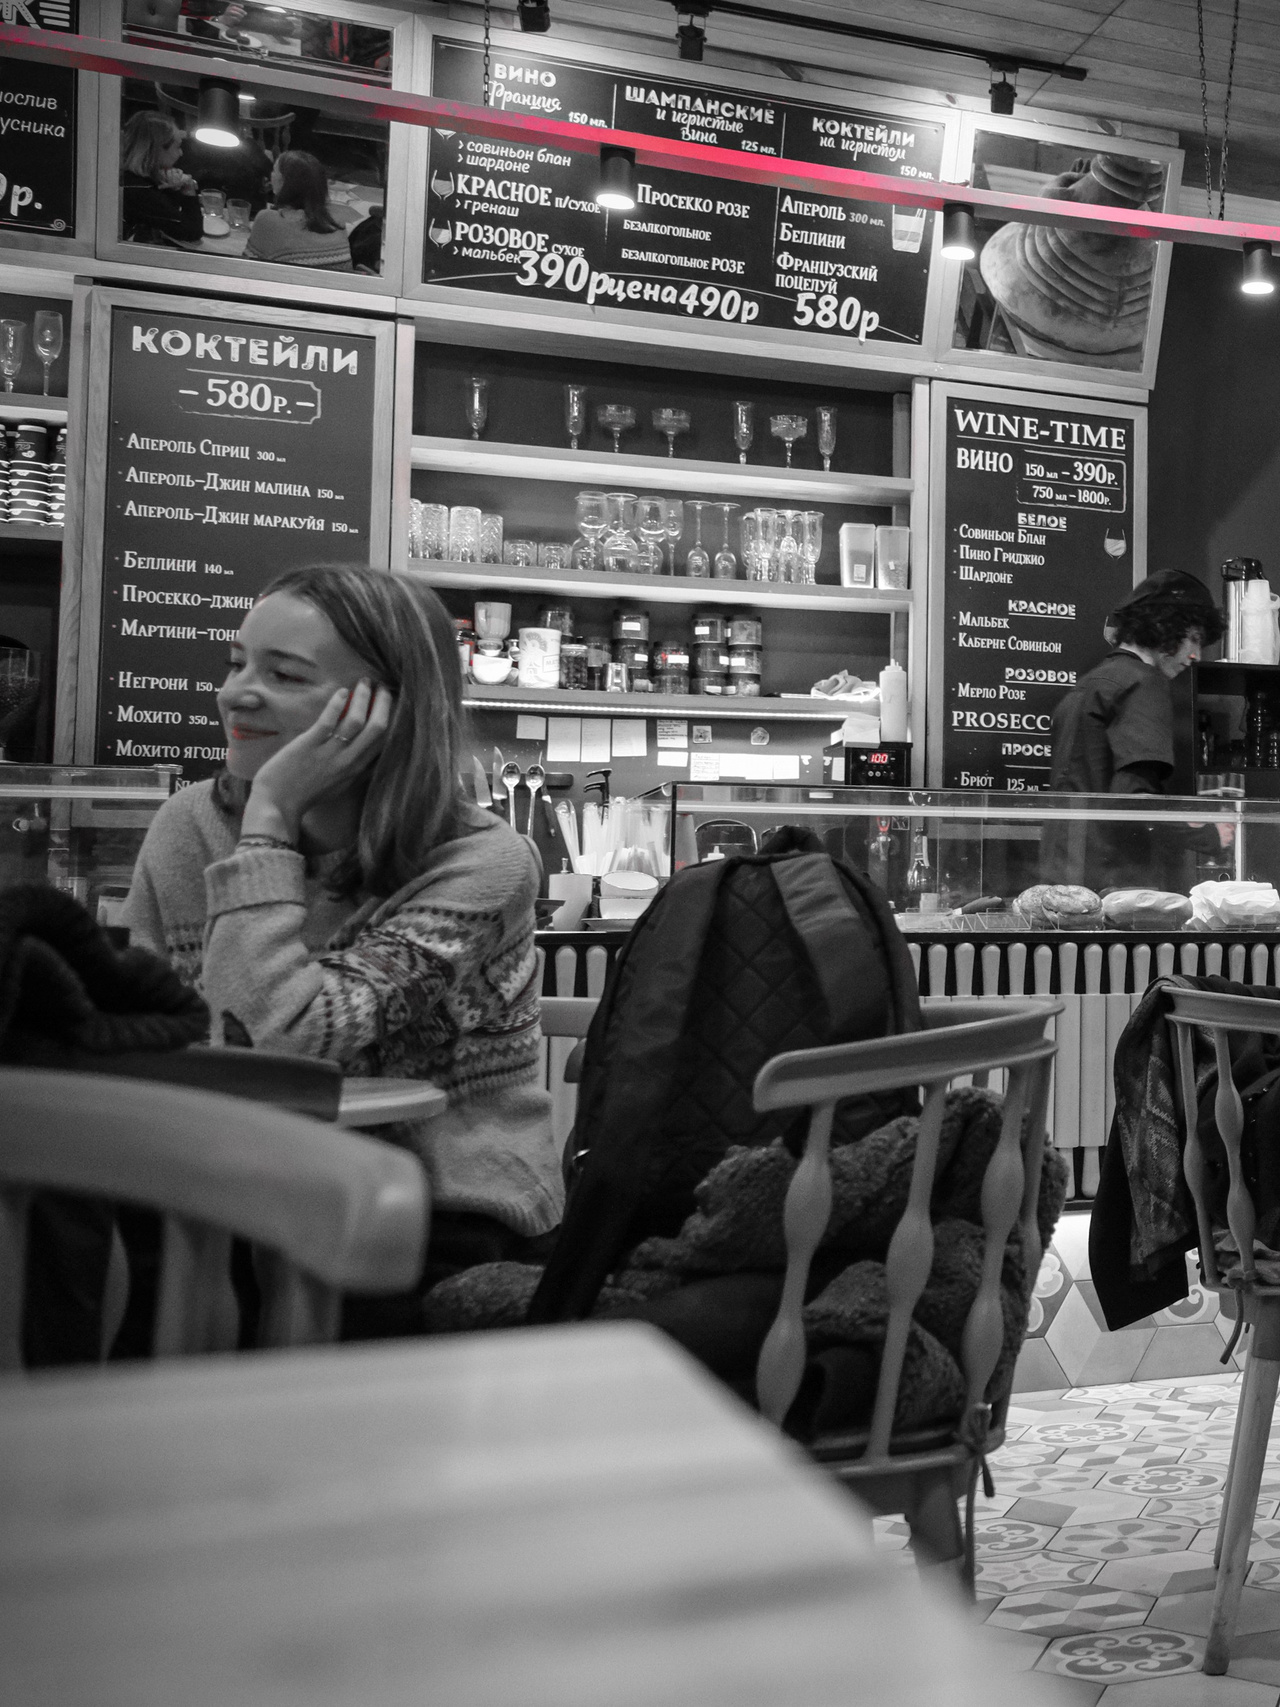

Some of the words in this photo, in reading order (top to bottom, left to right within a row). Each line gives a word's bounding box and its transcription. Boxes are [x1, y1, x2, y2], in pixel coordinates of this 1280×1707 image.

[494, 63, 556, 88] ВИНО
[625, 85, 775, 125] ШАМПАНСКИЕ
[568, 111, 588, 125] 150
[655, 108, 666, 121] и
[671, 110, 744, 134] игристые
[812, 117, 916, 148] КОКТЕЙЛИ
[466, 141, 534, 161] совиньон
[536, 148, 571, 167] блан
[741, 140, 758, 152] 125
[819, 136, 836, 149] на
[841, 138, 906, 162] игристом
[466, 154, 530, 173] шардоне
[900, 165, 917, 177] 150
[457, 173, 552, 207] КРАСНОЕ
[637, 183, 713, 213] Просекко
[716, 200, 750, 219] РОЗЕ
[464, 200, 519, 217] гренаш
[780, 194, 846, 221] Апероль
[849, 212, 868, 224] 300
[455, 221, 550, 253] РОЗОВОЕ
[551, 243, 585, 258] СУХОЕ
[623, 219, 712, 241] БЕЗАЛКОГОЛЬНОЕ
[779, 222, 846, 249] Беллини
[461, 246, 521, 264] мальбек
[621, 248, 709, 270] БЕЗАЛКОГОЛЬНОЕ
[711, 257, 746, 274] РОЗЕ
[776, 251, 878, 282] Французский
[775, 273, 838, 295] ПОЦЕЛУЙ
[793, 292, 880, 343] 580р
[132, 325, 358, 375] КОКТЕЙЛИ
[954, 408, 1126, 450] WINE-TIME
[126, 432, 196, 455] Апероль
[200, 438, 250, 461] Сприц
[256, 450, 275, 462] 300
[956, 447, 1013, 473] ВИНО
[1025, 463, 1044, 478] 150
[254, 481, 311, 498] МАЛИНА
[317, 488, 333, 500] 150
[1032, 485, 1053, 500] 750
[253, 514, 325, 531] МАРАКУЙЯ
[332, 522, 348, 533] 150
[1017, 512, 1067, 529] БЕЛОЕ
[959, 523, 1015, 543] Совиньон
[1017, 528, 1046, 546] Блан
[123, 551, 197, 573] Беллини
[204, 563, 222, 575] 140
[959, 544, 992, 561] Пино
[993, 546, 1045, 566] Гриджио
[959, 565, 1014, 584] Шардоне
[1008, 599, 1076, 616] КРАСНОЕ
[958, 611, 1010, 629] Мальбек
[958, 632, 1006, 650] Каберне
[1007, 635, 1062, 654] Совиньон
[118, 671, 188, 692] Негрони
[196, 681, 213, 692] 150
[1005, 667, 1077, 684] РОЗОВОЕ
[957, 682, 996, 699] Мерло
[999, 685, 1026, 701] Розе
[117, 705, 182, 724] Мохито
[189, 715, 208, 725] 350
[952, 710, 1053, 731] PROSECC
[115, 739, 181, 758] Мохито
[870, 753, 888, 764] 100
[960, 771, 994, 788] Брют
[1007, 778, 1026, 791] 125
